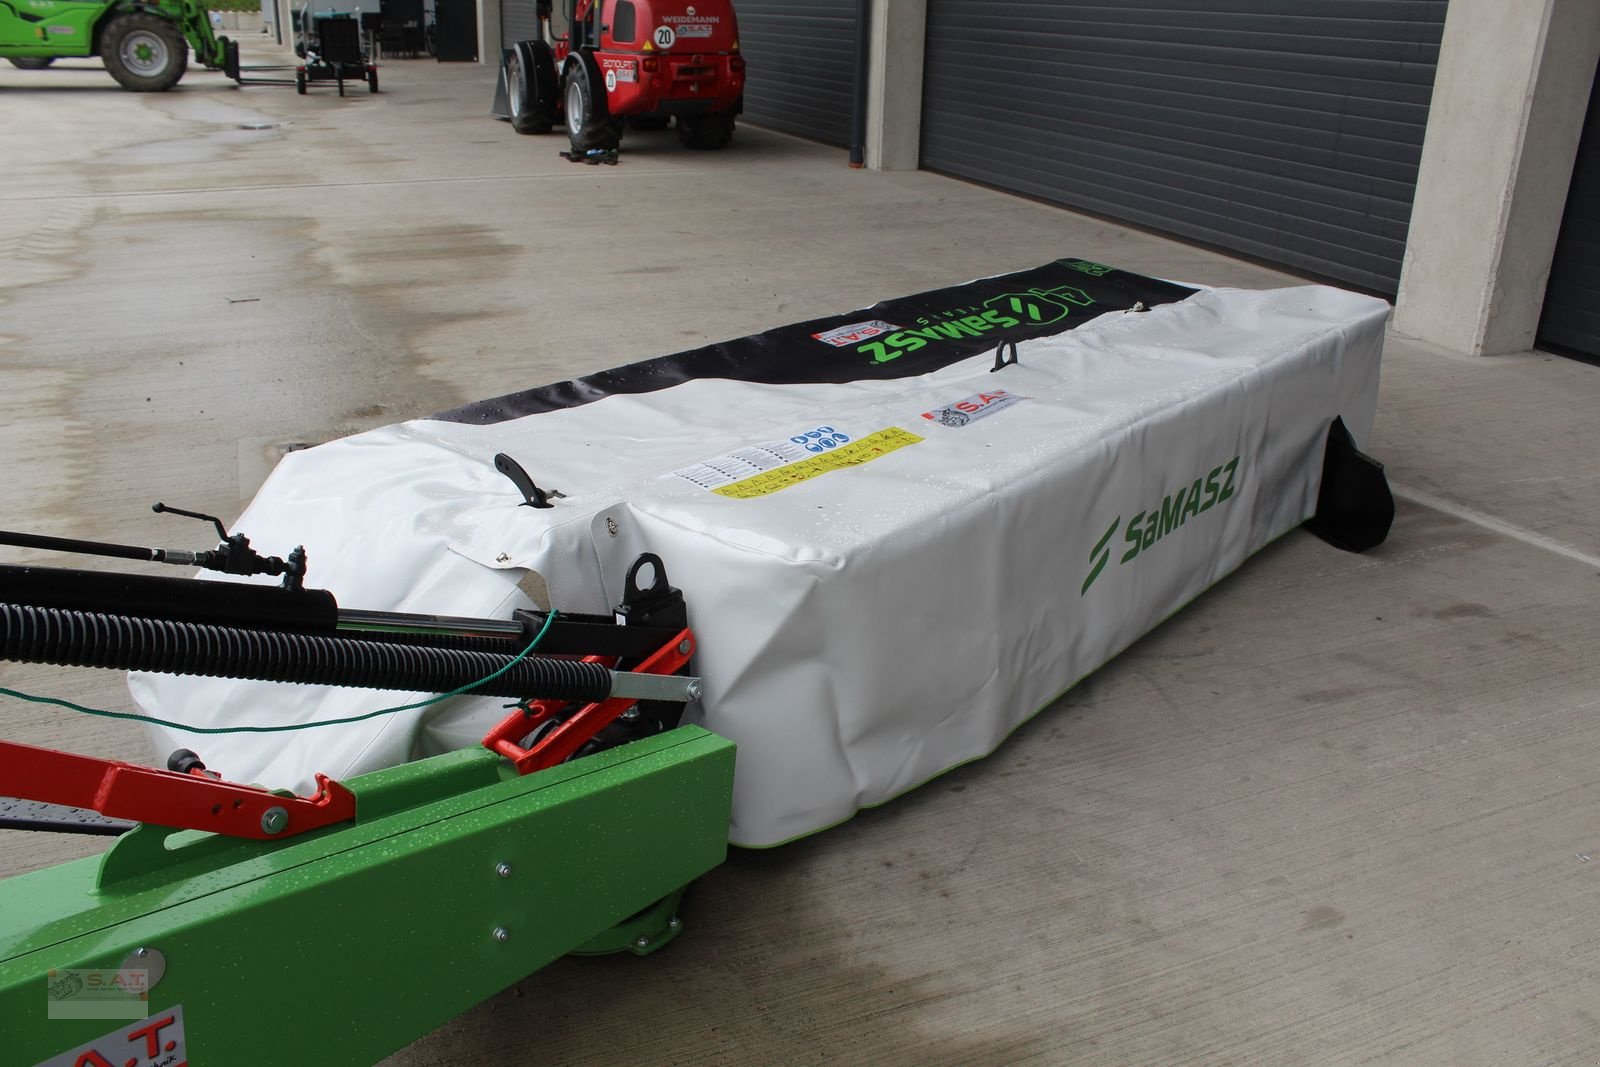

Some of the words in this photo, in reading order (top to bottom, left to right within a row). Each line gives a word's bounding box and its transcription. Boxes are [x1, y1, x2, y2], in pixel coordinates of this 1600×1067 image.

[662, 16, 720, 24] WEIDEMANN
[658, 29, 671, 44] 20
[608, 73, 615, 88] 20
[1120, 455, 1240, 565] SaMASZ
